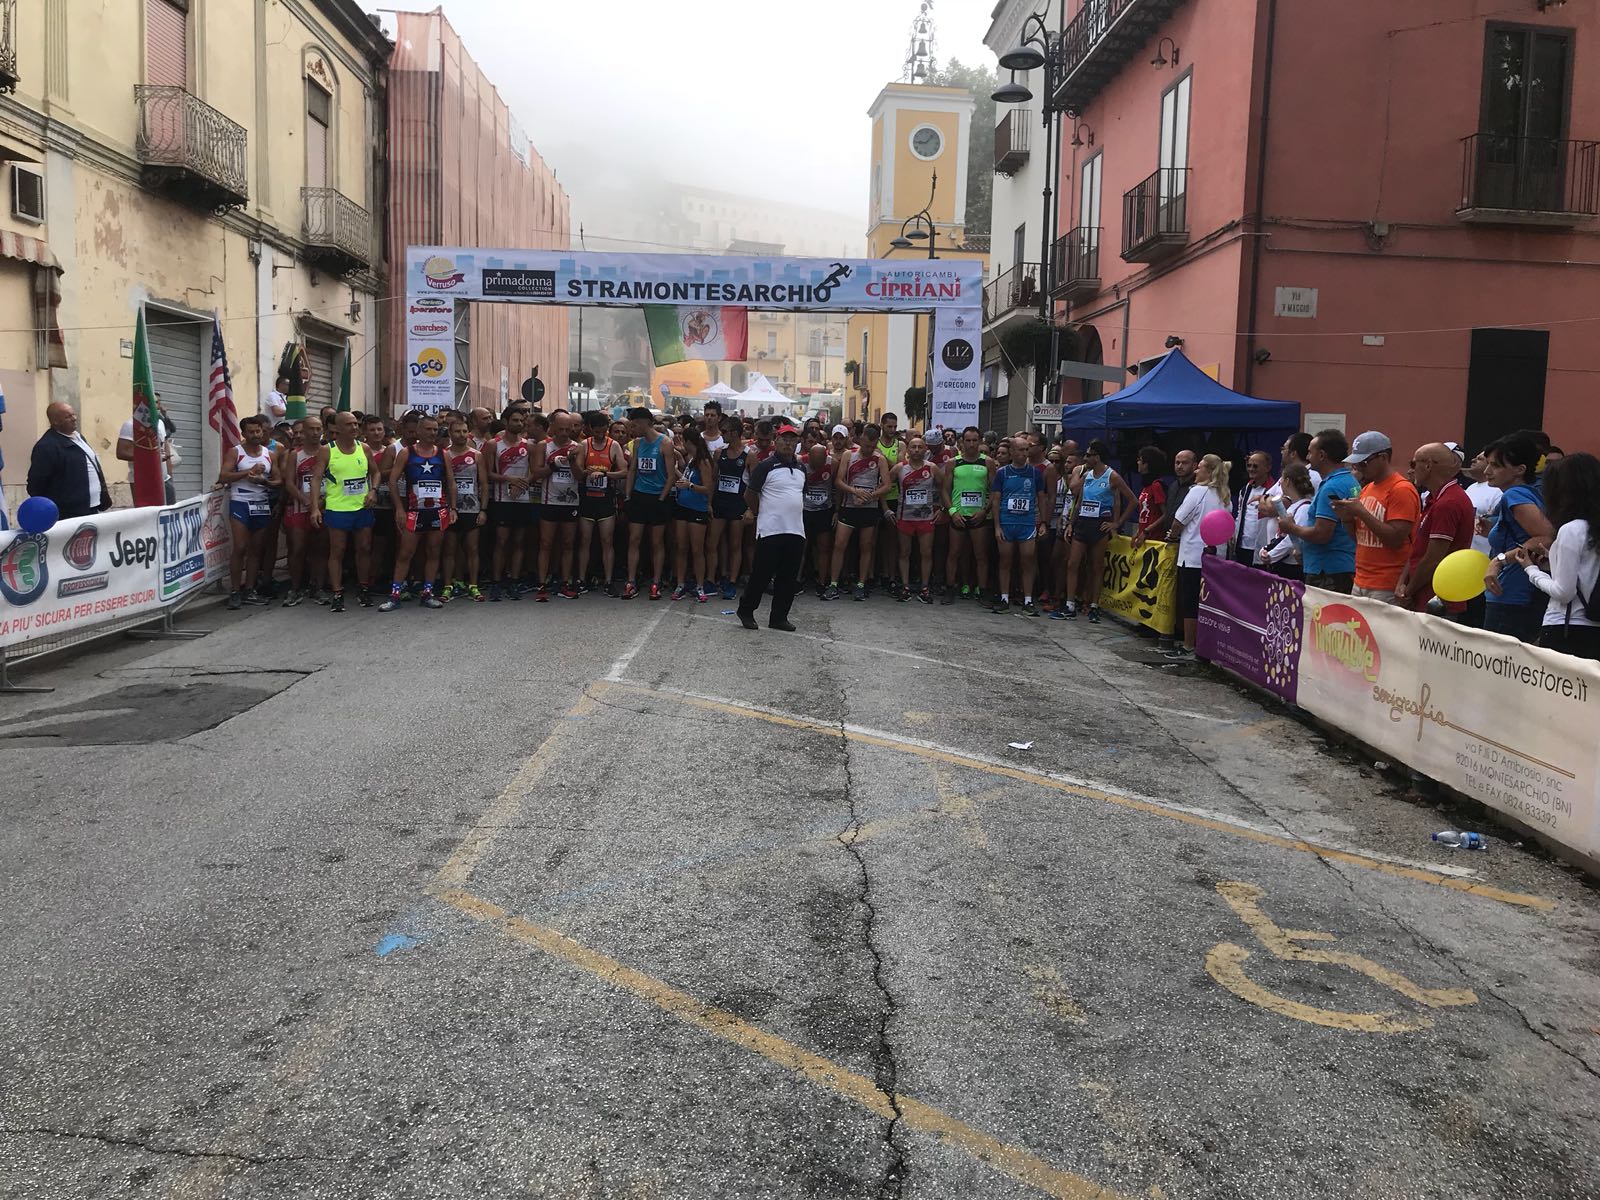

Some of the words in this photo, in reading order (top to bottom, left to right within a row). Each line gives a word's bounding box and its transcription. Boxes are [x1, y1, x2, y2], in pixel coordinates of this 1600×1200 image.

[427, 279, 456, 288] Verruso
[485, 271, 552, 289] primadonna
[567, 279, 831, 303] STRAMONTESARCHIO
[865, 276, 961, 298] CIPRIANI
[414, 324, 448, 332] marchese
[947, 346, 970, 357] LIZ
[409, 358, 444, 377] Decò
[944, 401, 957, 410] Edil
[958, 402, 977, 410] Vetro
[1012, 499, 1027, 510] 392
[160, 511, 182, 565] TOP
[183, 507, 203, 556] CAR
[109, 531, 157, 569] Jeep
[165, 559, 195, 581] SERVICE
[35, 607, 72, 628] SICURA
[73, 602, 93, 619] PER
[94, 594, 129, 613] ESSERE
[129, 588, 156, 606] SICURI
[1418, 635, 1588, 703] www.innovativestore.it
[1465, 742, 1477, 754] via
[1546, 776, 1562, 792] snc
[1455, 752, 1478, 773] 82016
[1480, 764, 1550, 805] MONTESARCHIO
[1552, 795, 1572, 818] (BN)
[1503, 792, 1523, 812] 0824
[1525, 803, 1557, 829] 833392
